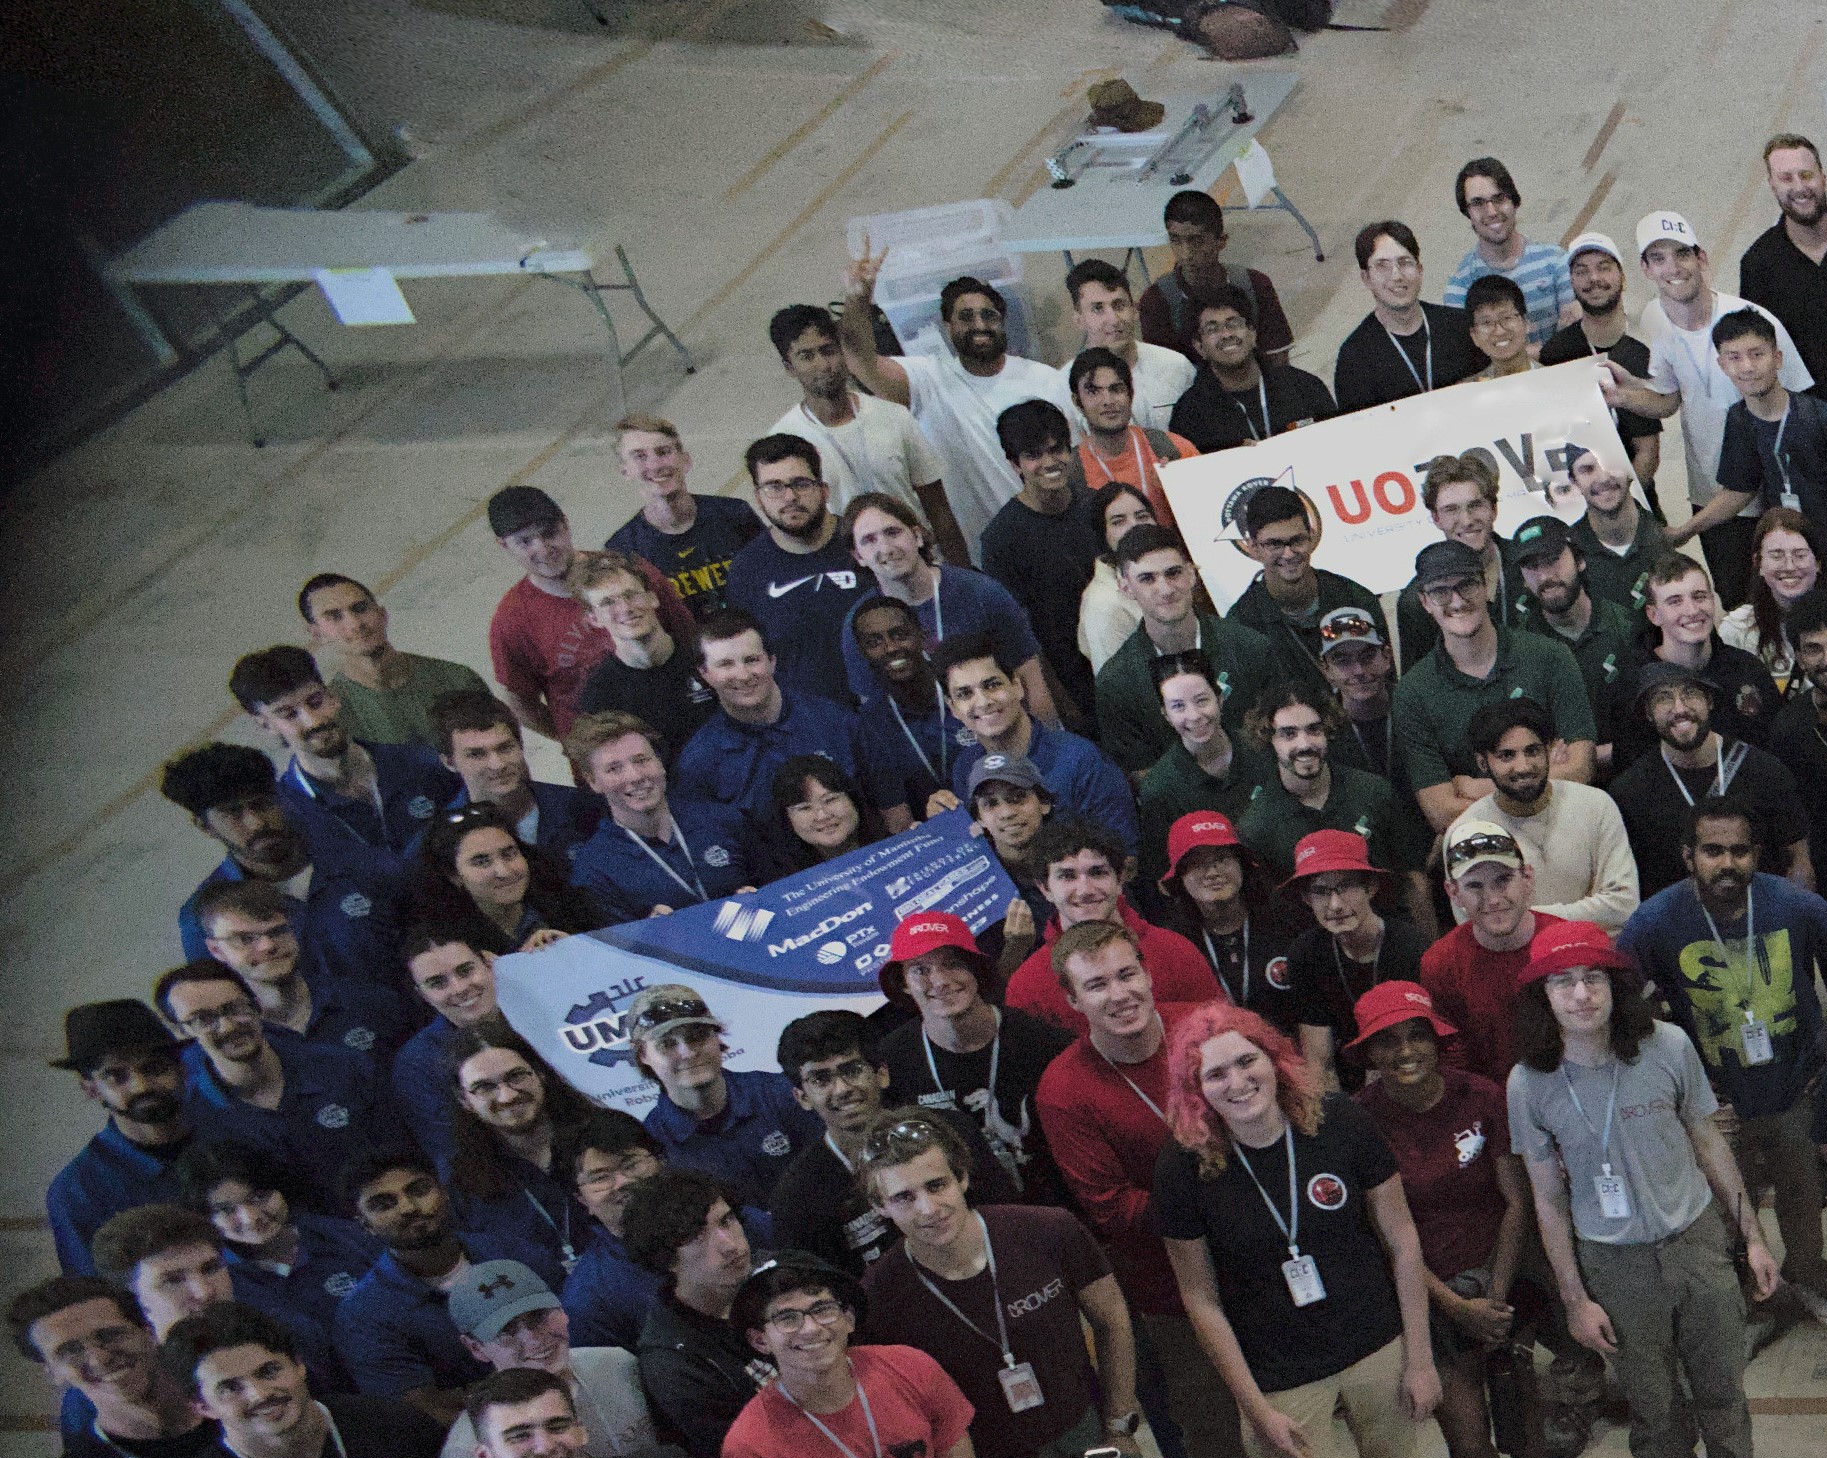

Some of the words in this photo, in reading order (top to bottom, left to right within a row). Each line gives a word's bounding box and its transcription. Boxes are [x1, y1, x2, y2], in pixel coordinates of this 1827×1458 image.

[1660, 218, 1687, 234] CIC
[803, 865, 863, 893] University
[785, 882, 850, 917] Engineering
[768, 901, 874, 958] MacDon
[558, 1011, 630, 1053] UM
